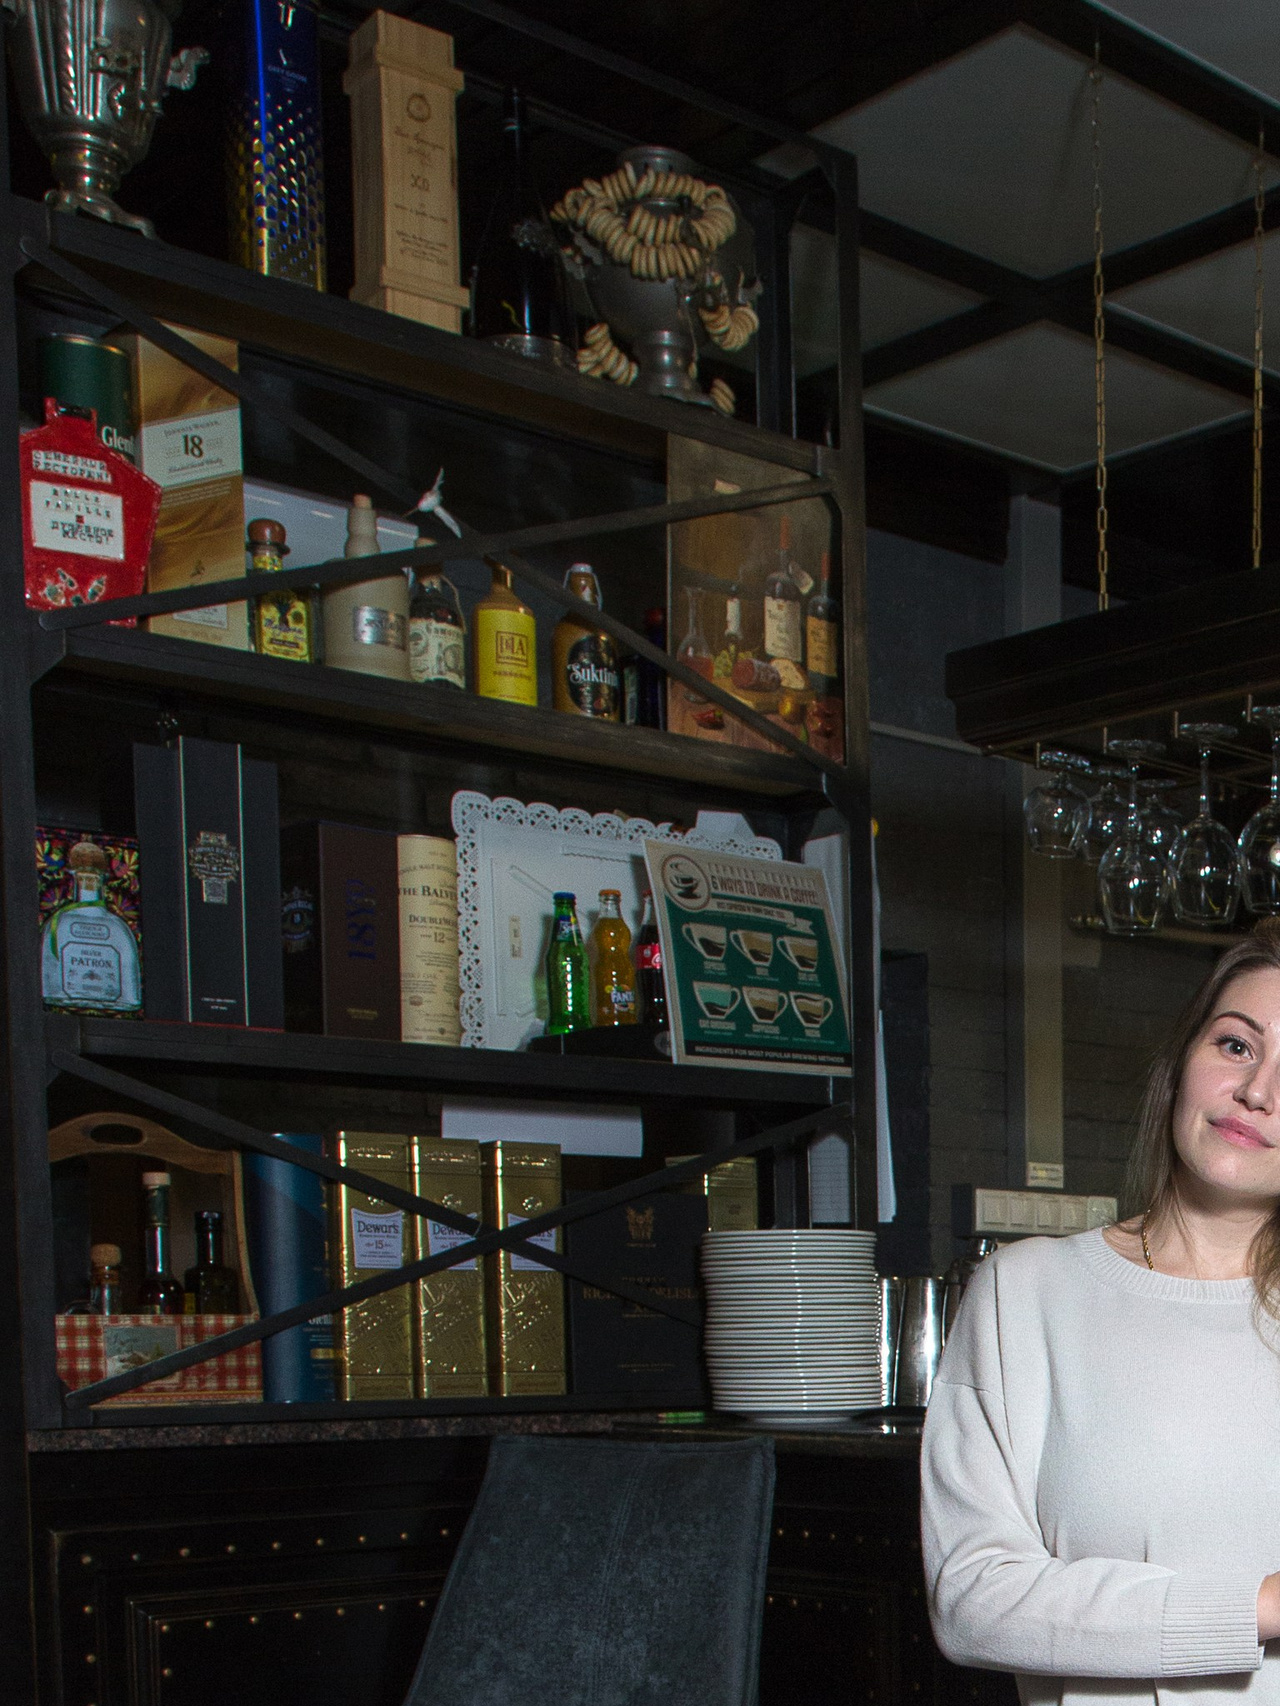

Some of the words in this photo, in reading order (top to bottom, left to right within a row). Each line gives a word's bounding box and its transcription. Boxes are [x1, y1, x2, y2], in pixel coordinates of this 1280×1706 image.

[182, 433, 205, 458] 18
[711, 874, 719, 891] 6
[720, 876, 742, 894] WAYS
[743, 880, 756, 896] TO
[757, 882, 782, 900] DRINK
[434, 931, 446, 944] 12
[694, 1045, 734, 1055] INGREDIENTS
[748, 1049, 764, 1057] MOST
[764, 1050, 791, 1059] POPULAR
[792, 1052, 817, 1061] BREWING
[818, 1054, 845, 1064] METHODS
[357, 1220, 400, 1234] Dewar's
[375, 1240, 384, 1249] 15
